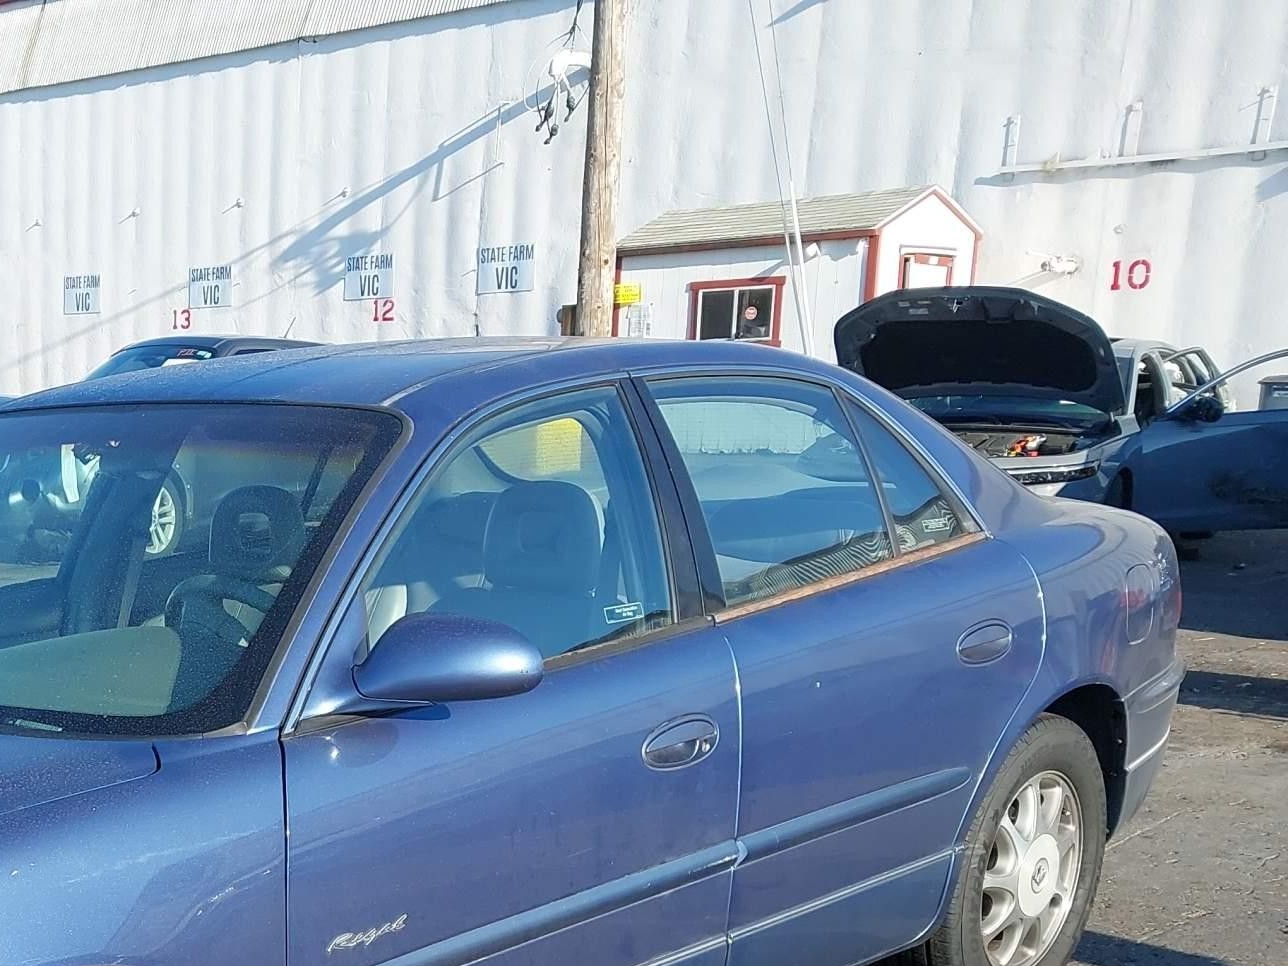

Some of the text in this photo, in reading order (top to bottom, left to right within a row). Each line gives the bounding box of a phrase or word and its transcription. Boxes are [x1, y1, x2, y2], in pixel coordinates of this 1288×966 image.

[347, 253, 393, 272] STATE FARM
[480, 244, 534, 264] STATE FARM
[65, 274, 100, 290] STATE FARM
[191, 265, 232, 282] STATE FARM
[495, 266, 518, 290] VIC
[1110, 259, 1151, 290] 10
[202, 285, 220, 305] VIC
[359, 275, 380, 296] VIC
[75, 292, 91, 311] VIC
[373, 300, 394, 321] 12
[172, 309, 191, 329] 13
[327, 912, 408, 953] Regal
